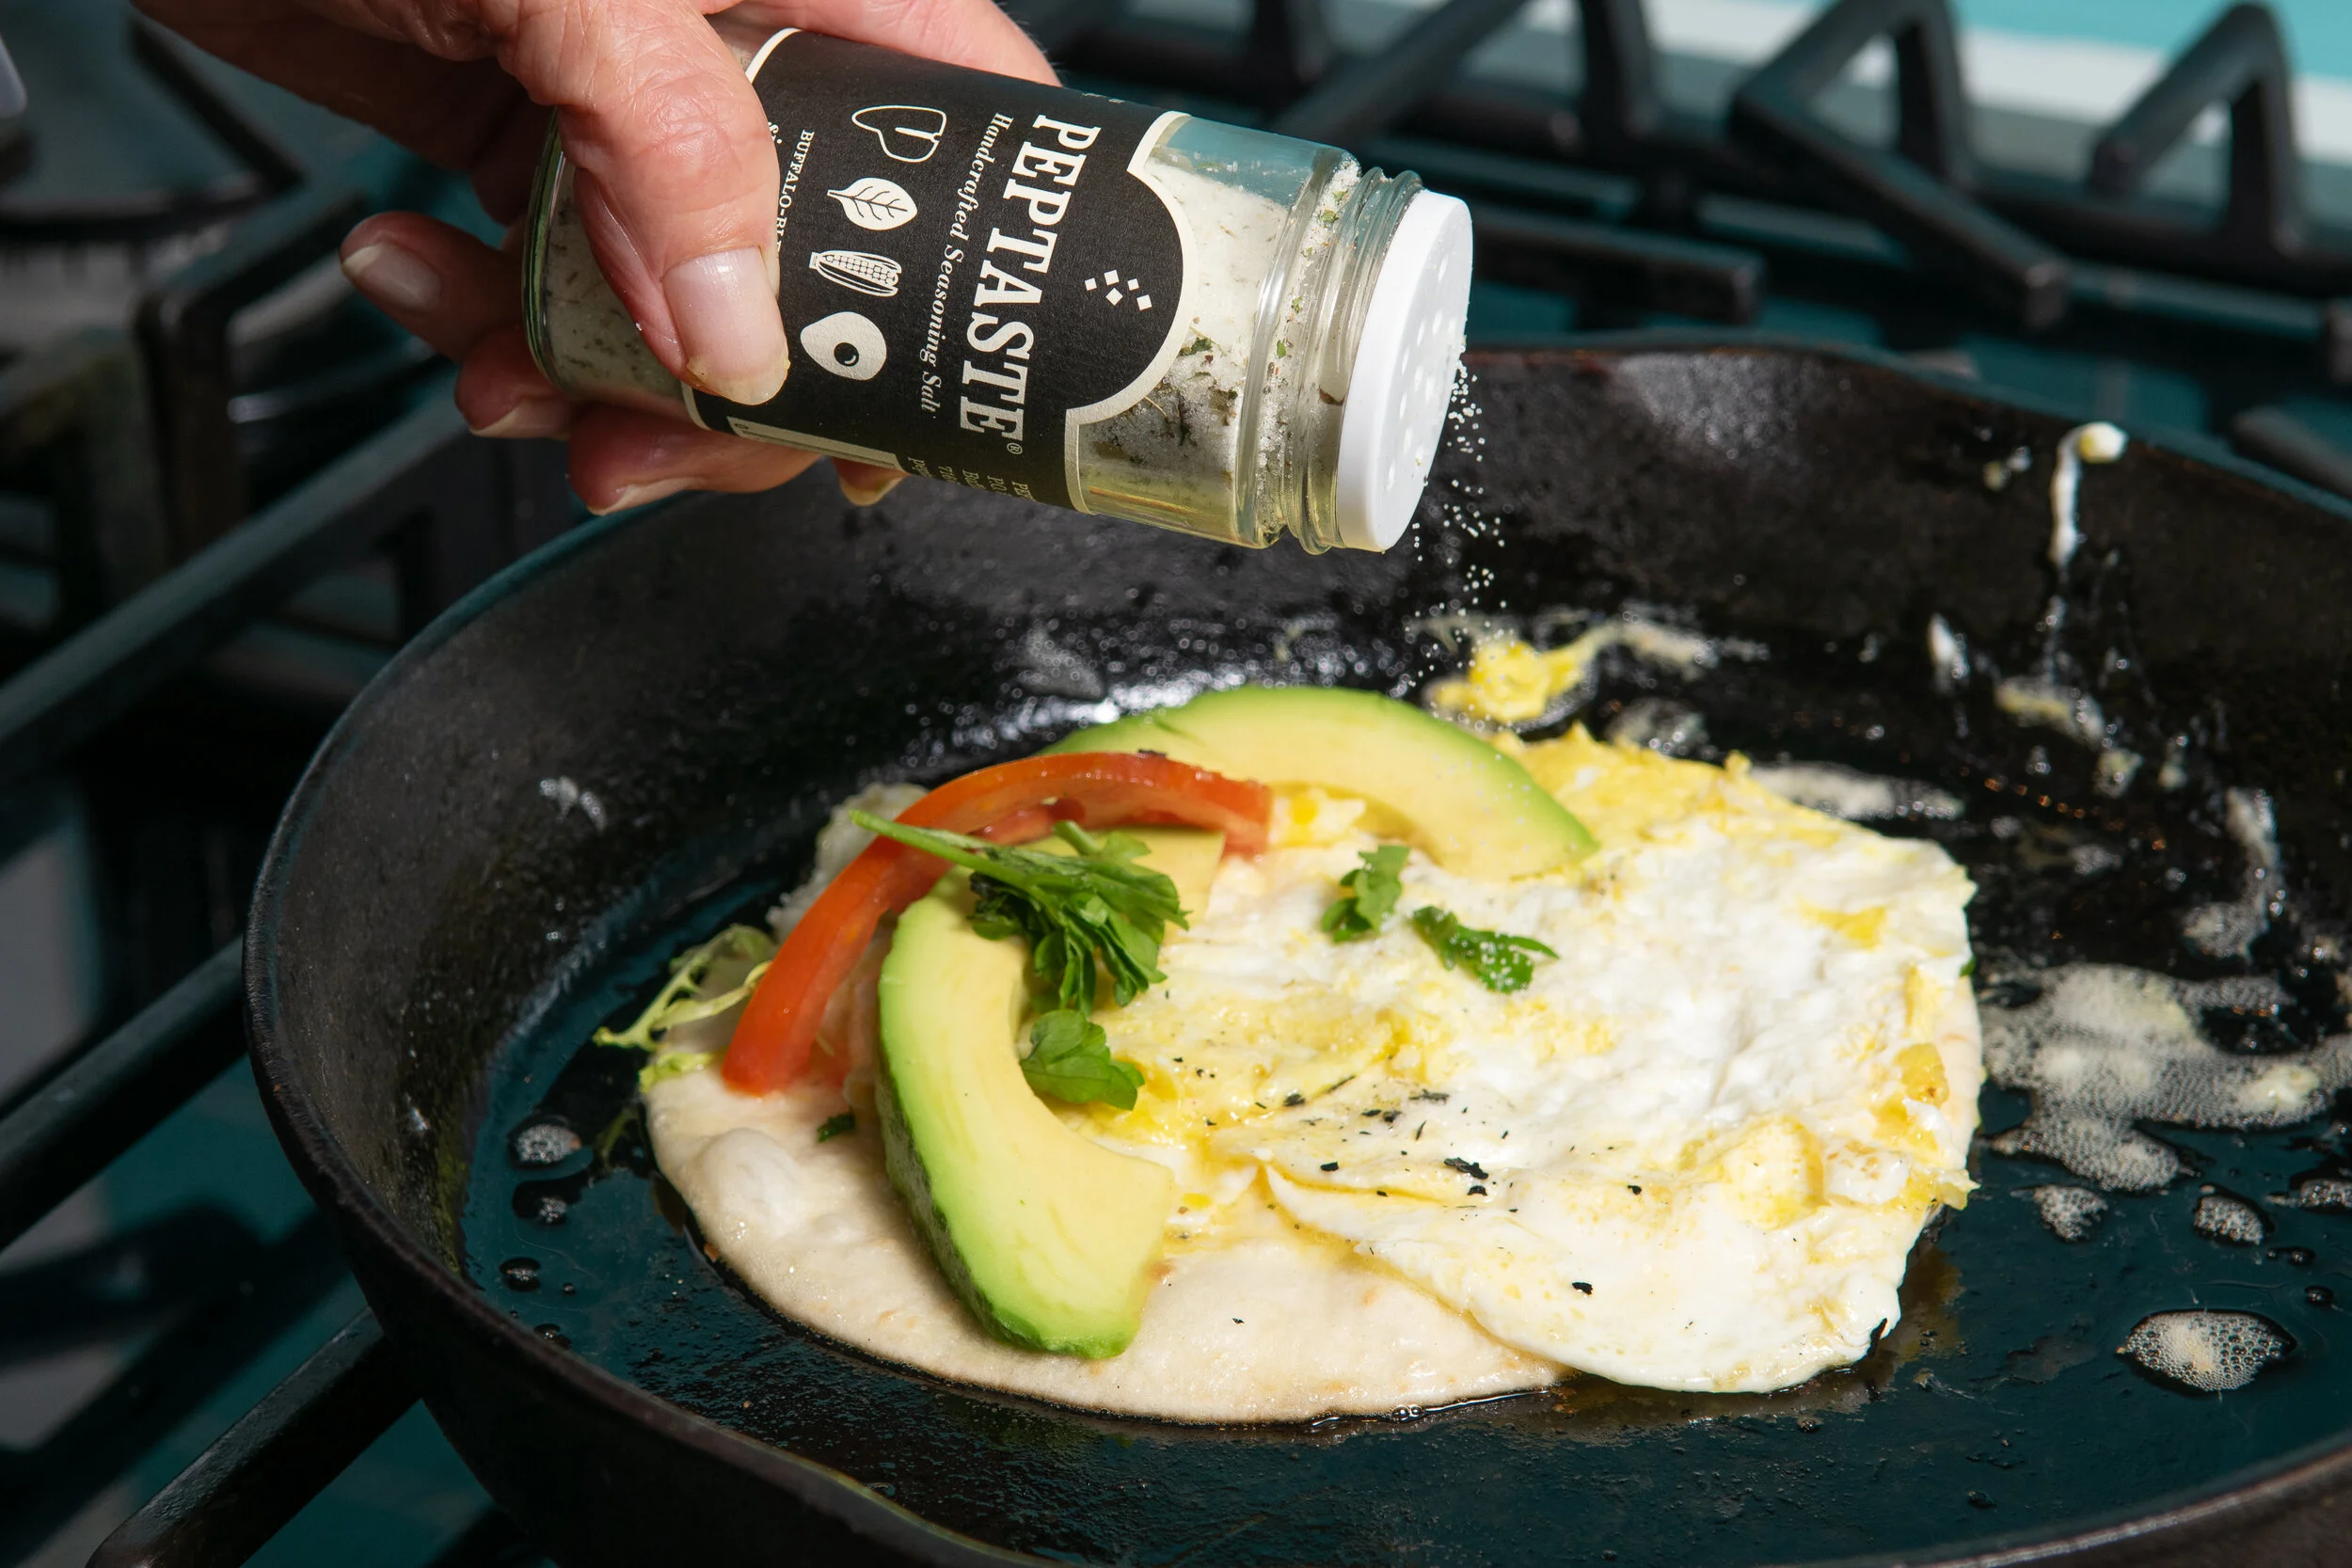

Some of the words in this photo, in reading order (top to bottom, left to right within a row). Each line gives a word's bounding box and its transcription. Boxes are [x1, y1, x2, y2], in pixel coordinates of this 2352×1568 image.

[949, 113, 1014, 241] Handcrafted
[919, 245, 964, 368] Seasoning
[920, 370, 943, 414] Salt
